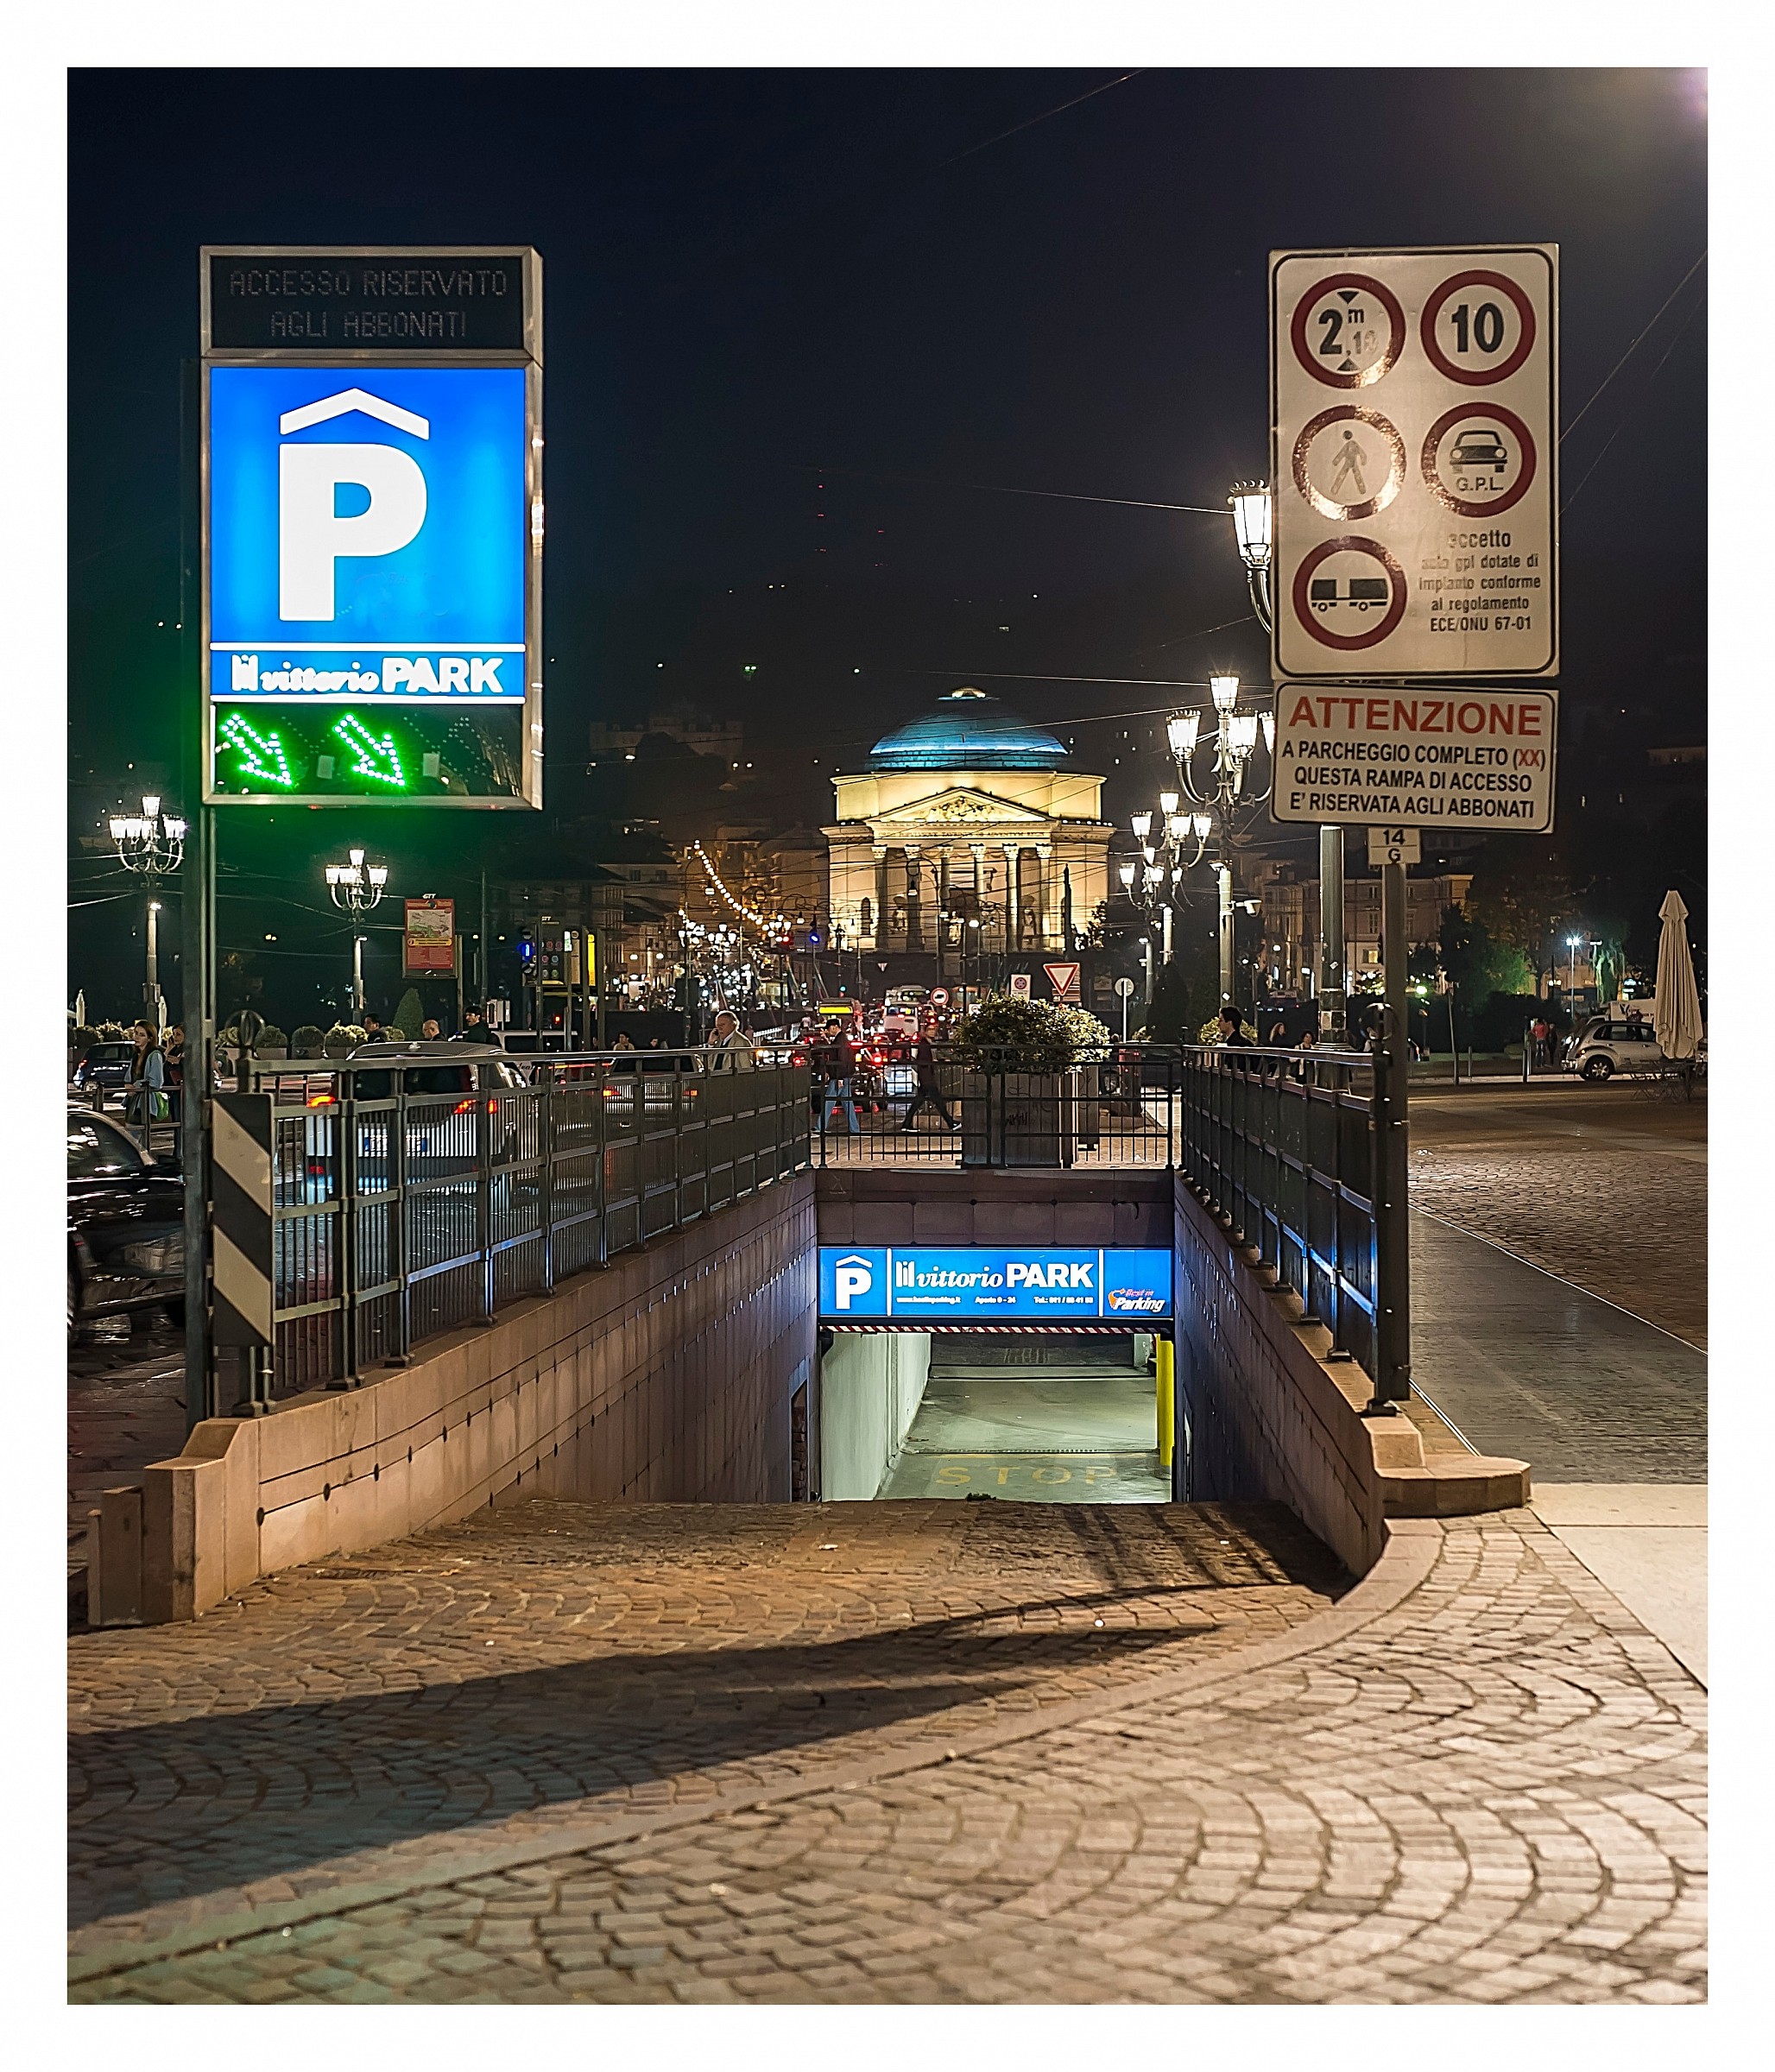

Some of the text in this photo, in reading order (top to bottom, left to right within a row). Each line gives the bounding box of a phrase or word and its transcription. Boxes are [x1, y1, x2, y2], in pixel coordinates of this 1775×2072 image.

[230, 269, 508, 296] ACCESSO RISERVATO
[270, 311, 467, 338] AGLI ABBONATI
[1451, 302, 1505, 354] 10
[279, 442, 428, 622] P
[1455, 554, 1475, 572] gpl
[1481, 554, 1521, 569] dotate
[1526, 553, 1539, 567] di
[1480, 574, 1541, 590] conforme
[1431, 595, 1530, 613] al regolamento
[1430, 615, 1532, 632] ECE/ONU 67-01
[382, 656, 504, 693] PARK
[1288, 695, 1543, 736] ATTENZIONE
[1282, 741, 1546, 771] A PARCHEGGIO COMPLETO (XX)
[1295, 766, 1532, 793] QUESTA RAMPA DI ACCESSO
[1290, 792, 1535, 818] E' RISERVATA AGLI ABBONATI
[1382, 829, 1406, 845] 14
[1387, 849, 1401, 863] G
[836, 1267, 873, 1310] P
[916, 1266, 1004, 1288] vittorio
[1006, 1263, 1095, 1288] PARK
[1112, 1297, 1165, 1313] Parking
[935, 1467, 1117, 1485] STOP
